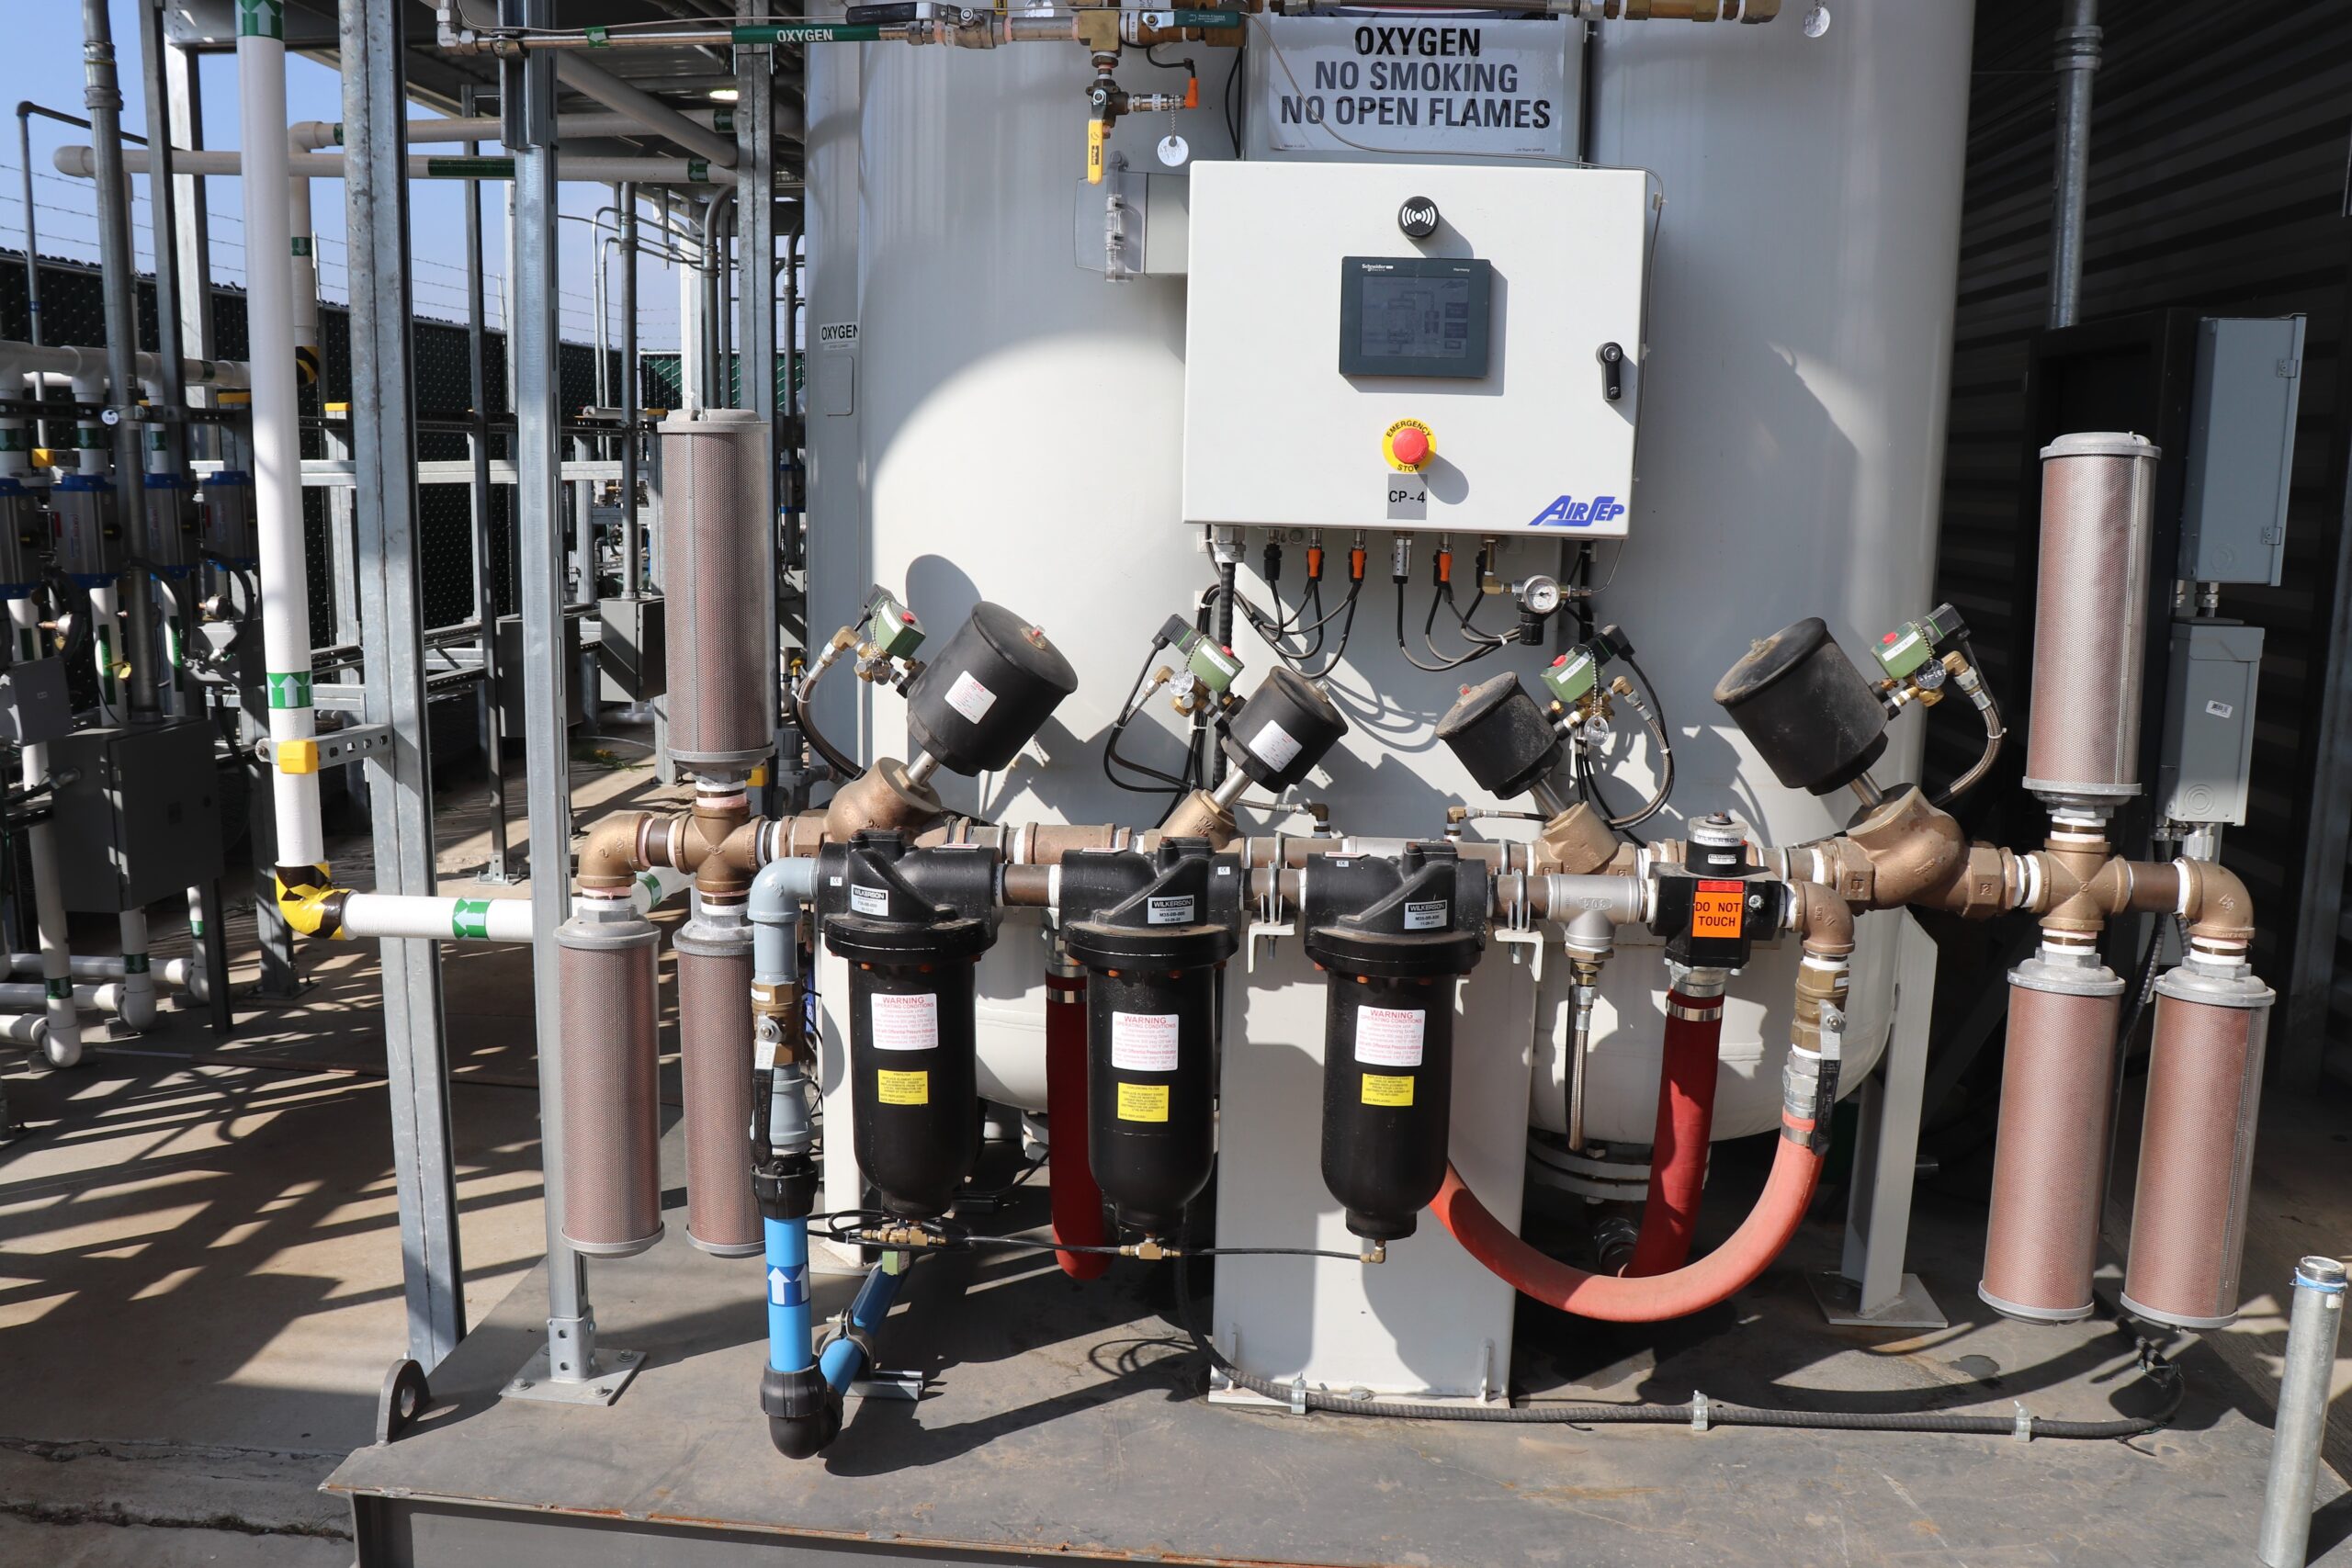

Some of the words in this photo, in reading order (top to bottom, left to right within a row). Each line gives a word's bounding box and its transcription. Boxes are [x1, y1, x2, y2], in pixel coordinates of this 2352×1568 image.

[776, 28, 833, 42] OXYGEN
[1354, 26, 1481, 57] OXYGEN
[1315, 61, 1360, 90] NO
[1370, 62, 1518, 93] SMOKING
[1281, 96, 1325, 125] NO
[1336, 96, 1419, 126] OPEN
[1429, 97, 1551, 129] FLAMES
[821, 324, 858, 341] OXYGEN
[1385, 420, 1431, 438] EMERGENCY
[1396, 463, 1419, 472] STOP
[1388, 490, 1426, 503] CP-4
[854, 888, 885, 899] WILKERSON
[1153, 899, 1192, 908] WILKERSON
[1409, 902, 1445, 912] WILKERSON
[1695, 901, 1711, 912] DO
[1718, 902, 1741, 913] NOT
[1698, 916, 1736, 927] TOUCH
[883, 996, 925, 1004] WARNING
[1124, 1016, 1167, 1024] WARNING
[1371, 1010, 1413, 1020] WARNING
